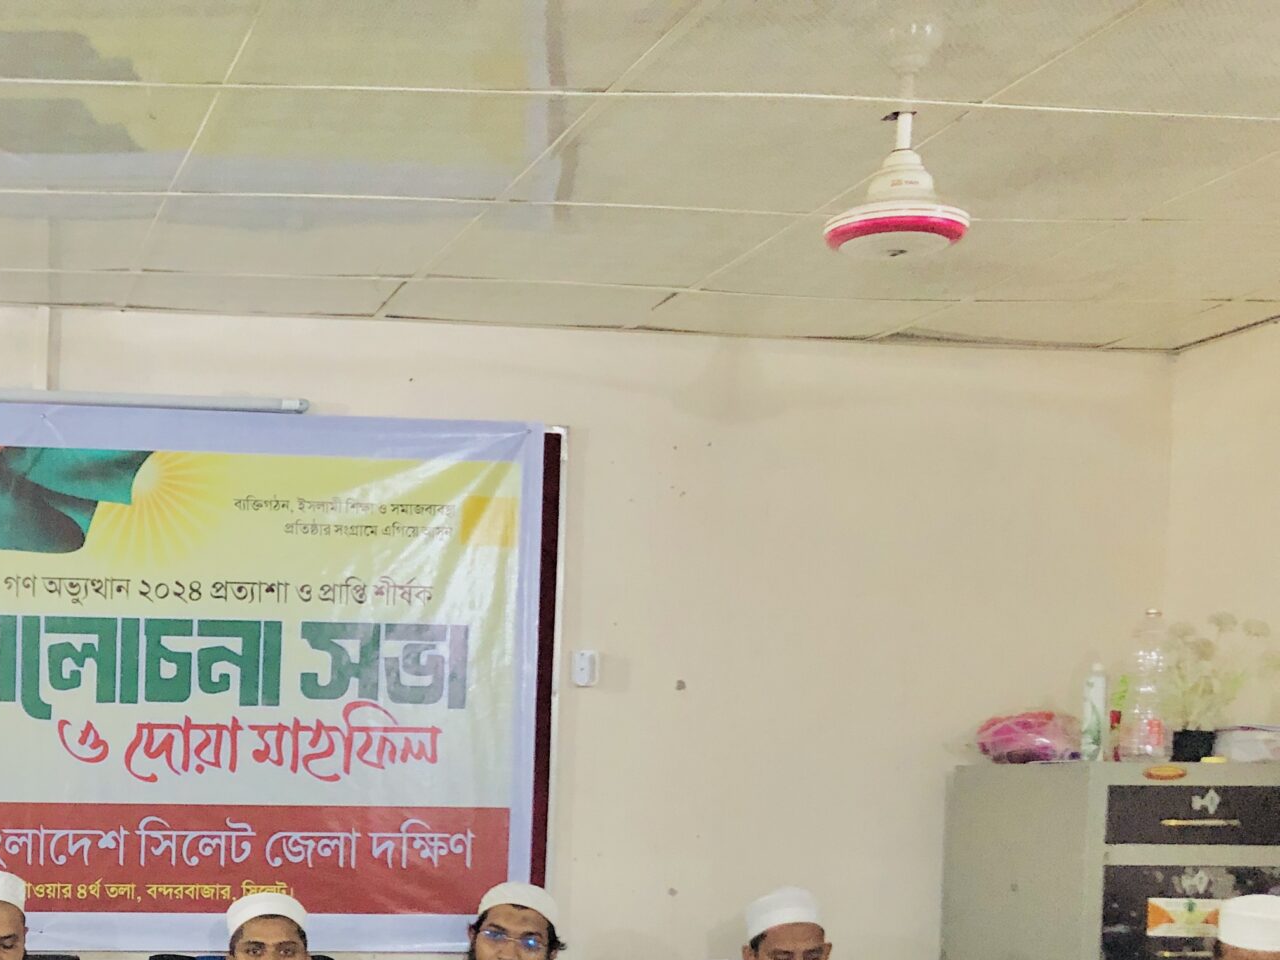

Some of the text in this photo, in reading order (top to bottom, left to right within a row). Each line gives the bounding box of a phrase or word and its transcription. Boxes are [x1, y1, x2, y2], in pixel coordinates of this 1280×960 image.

[379, 504, 387, 514] ও
[334, 524, 378, 537] সংগ্রামে
[4, 574, 37, 598] গণ
[41, 576, 131, 607] অভ্যুত্থান
[139, 578, 202, 603] ২০২৪
[210, 580, 290, 604] প্রত্যাশা
[296, 582, 312, 603] ও
[320, 576, 368, 605] প্রাপ্তি
[373, 575, 434, 606] শীর্ষক
[300, 621, 469, 709] সভা
[57, 701, 442, 782] ও দোয়া মাহফিল
[135, 815, 257, 868] সিলেট
[265, 826, 361, 869] জেলা
[368, 818, 476, 869] দক্ষিণ
[76, 878, 103, 899] ৪র্থ
[104, 883, 141, 903] তলা,
[145, 883, 237, 902] বন্দরবাজার,
